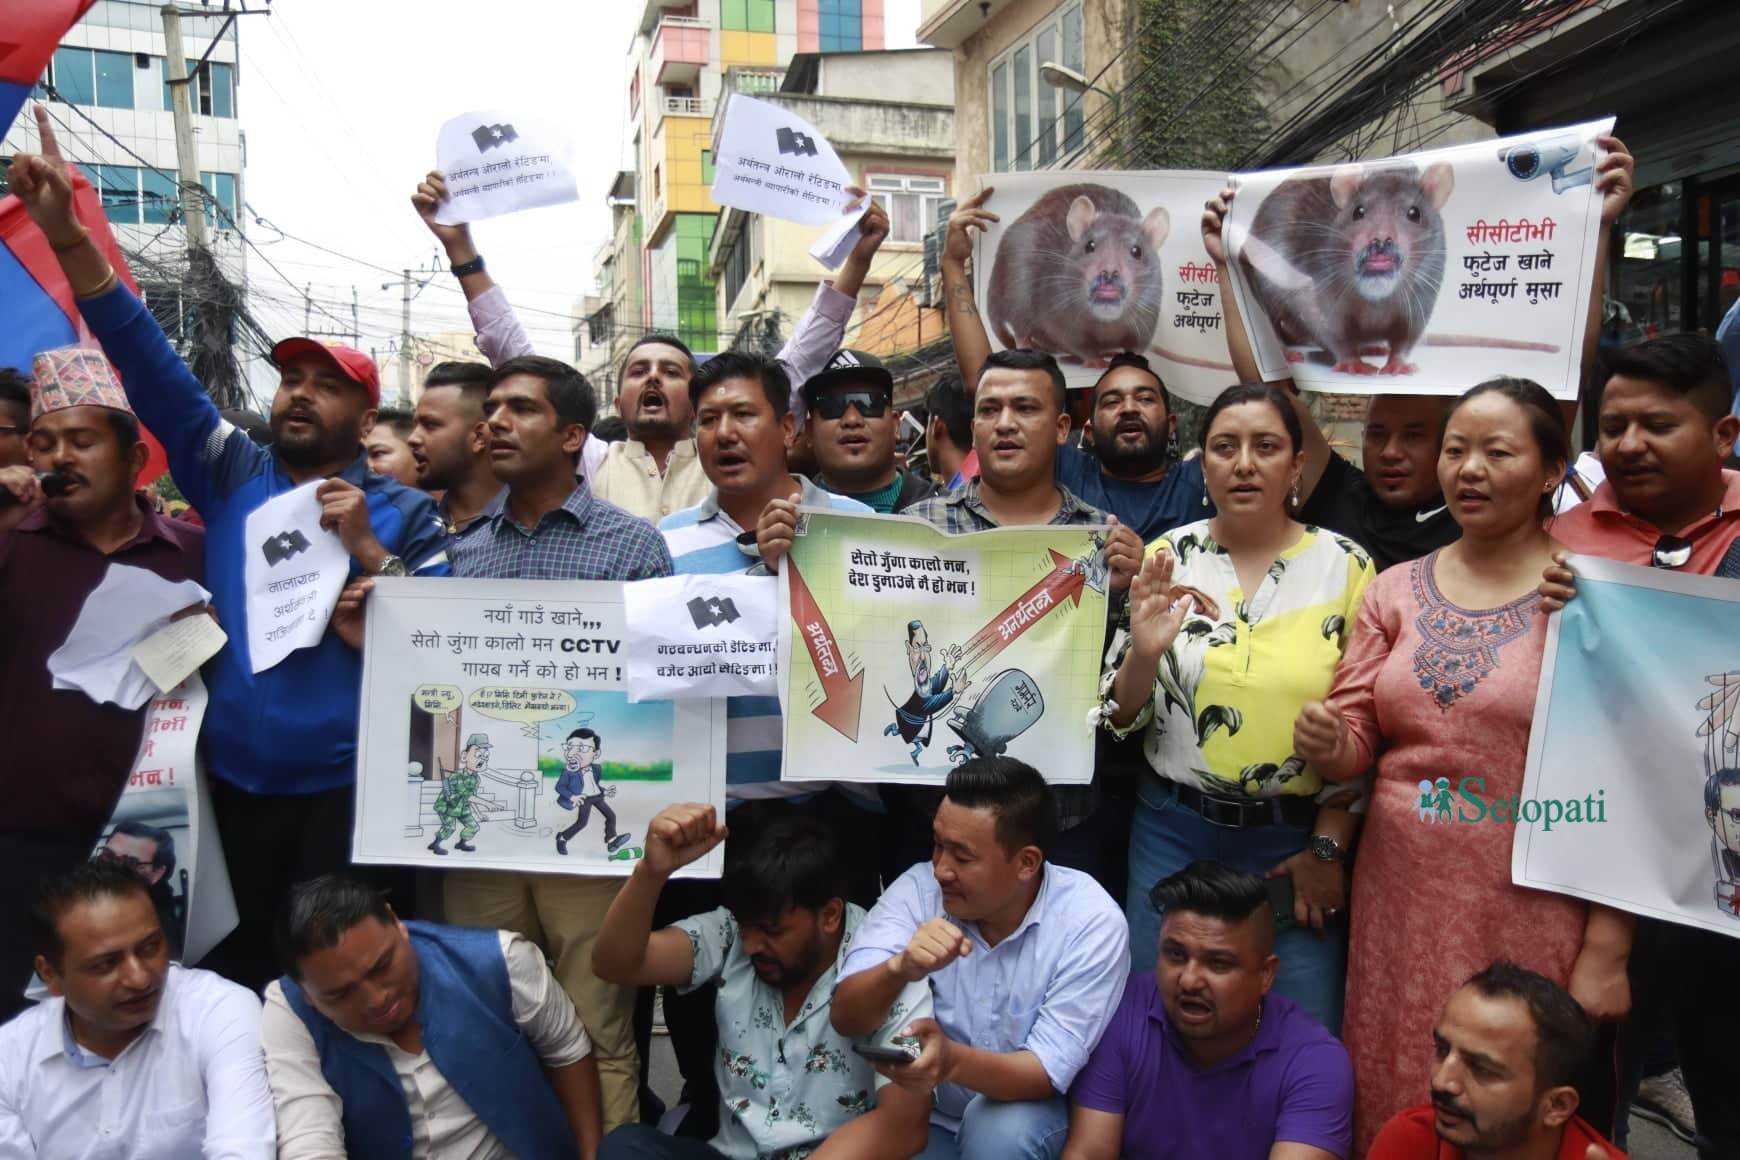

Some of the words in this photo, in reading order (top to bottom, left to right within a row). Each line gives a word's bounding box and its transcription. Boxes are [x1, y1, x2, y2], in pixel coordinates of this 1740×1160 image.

[773, 165, 806, 182] ओरालो
[1466, 217, 1557, 246] सीसीटीभी
[1463, 250, 1510, 277] फुटेज
[1517, 249, 1555, 270] खाने
[1176, 288, 1215, 311] फुटेज
[1459, 277, 1519, 304] अर्थपूर्ण
[1526, 282, 1563, 305] मुसा
[1173, 311, 1222, 334] अर्थपूर्ण
[851, 549, 877, 566] सेतो
[880, 551, 907, 572] जुँगा
[908, 555, 941, 572] कालो
[943, 560, 970, 575] मन,
[268, 570, 321, 593] नालायक
[848, 569, 869, 586] देश
[931, 576, 945, 593] हो
[484, 603, 513, 624] नयाँ
[518, 604, 545, 624] गाउँ
[998, 588, 1054, 640] अनर्थतन्त्र
[411, 629, 441, 649] सेतो
[447, 632, 478, 654] जुंगा
[485, 633, 525, 651] कालो
[532, 637, 554, 652] मन
[560, 638, 622, 654] CCTV
[462, 661, 502, 677] गायब
[508, 660, 531, 678] गर्ने
[536, 660, 557, 679] को
[564, 661, 581, 680] हो
[688, 662, 716, 677] आयो
